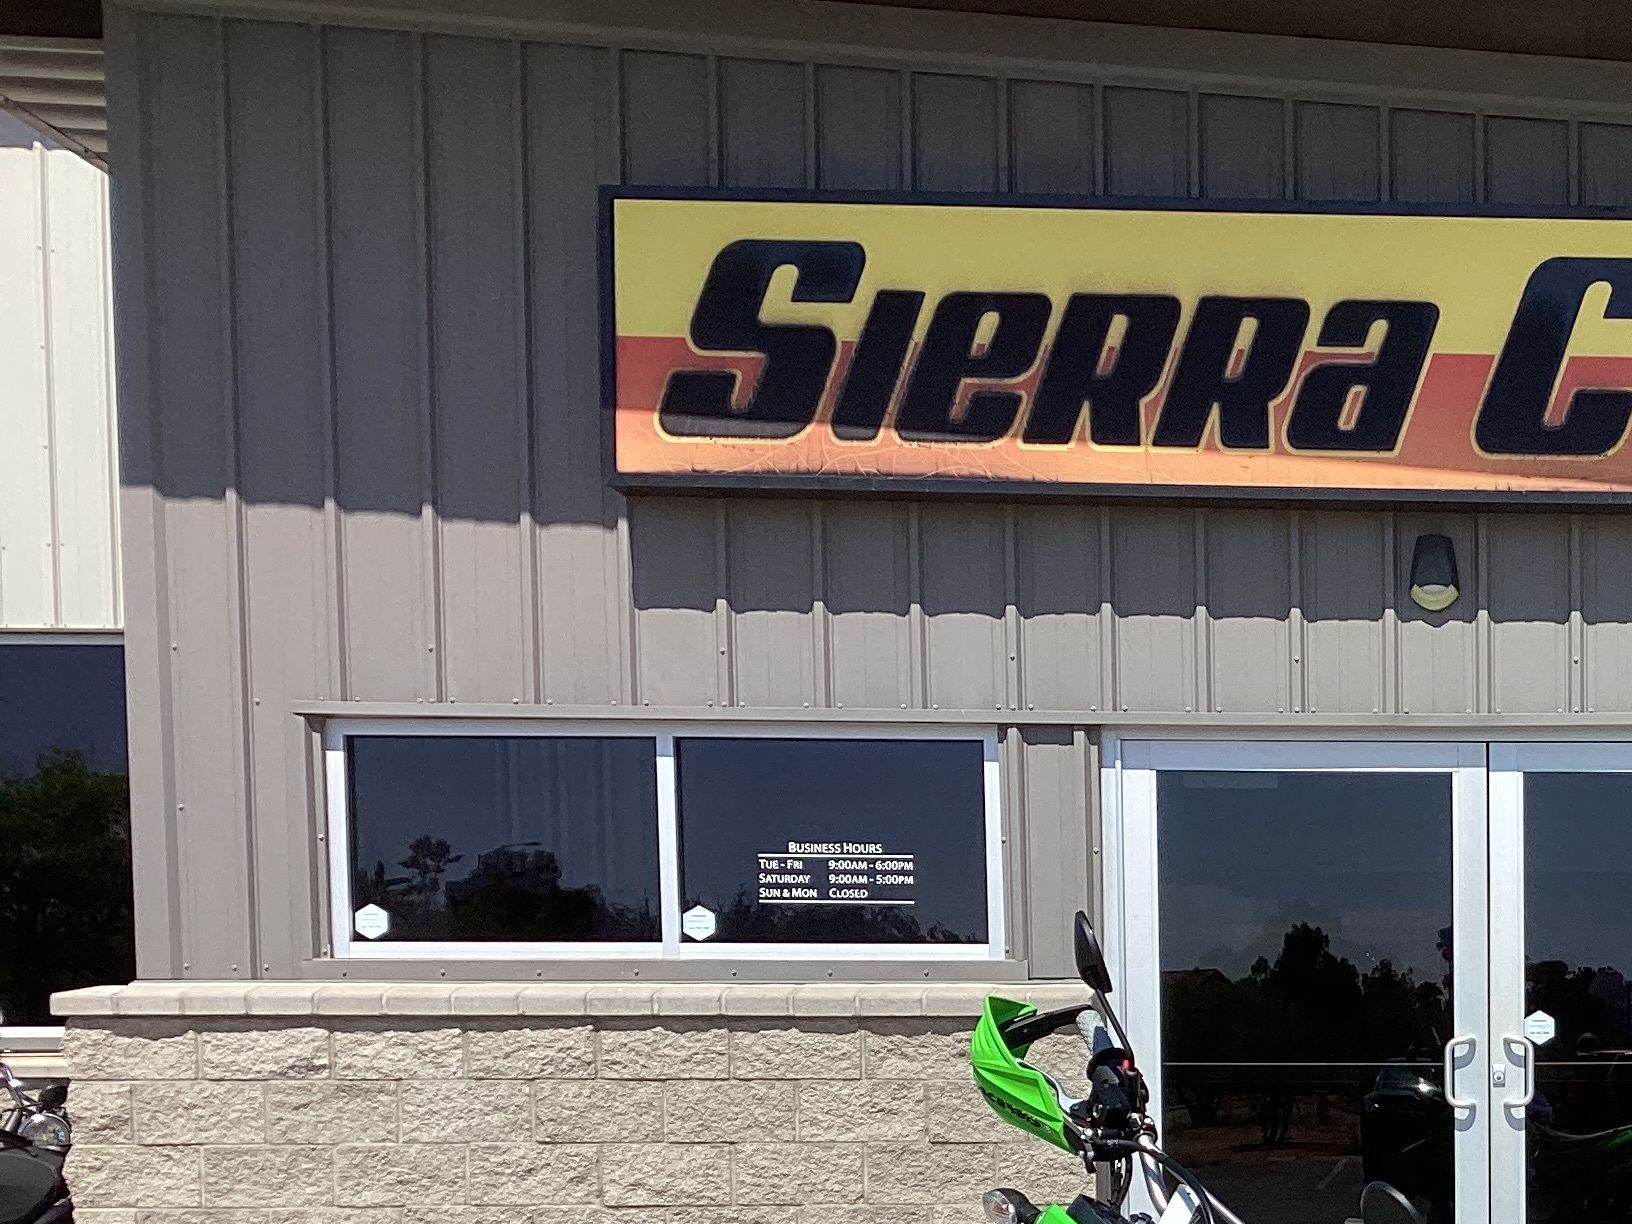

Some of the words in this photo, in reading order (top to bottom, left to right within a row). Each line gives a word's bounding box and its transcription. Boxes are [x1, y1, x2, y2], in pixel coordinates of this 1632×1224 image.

[788, 841, 841, 853] BUSINESS
[843, 842, 883, 854] HOURS
[758, 859, 779, 870] TUE
[787, 859, 803, 870] FRI
[828, 860, 867, 870] 9:00AM
[875, 860, 914, 871] 6:00PM
[758, 873, 811, 884] SATURDAY
[828, 874, 868, 884] 9:00AM
[875, 874, 914, 885] 5:00PM
[759, 887, 781, 898] SUN
[782, 889, 790, 898] &
[791, 888, 818, 898] MON
[828, 888, 869, 899] CLOSED
